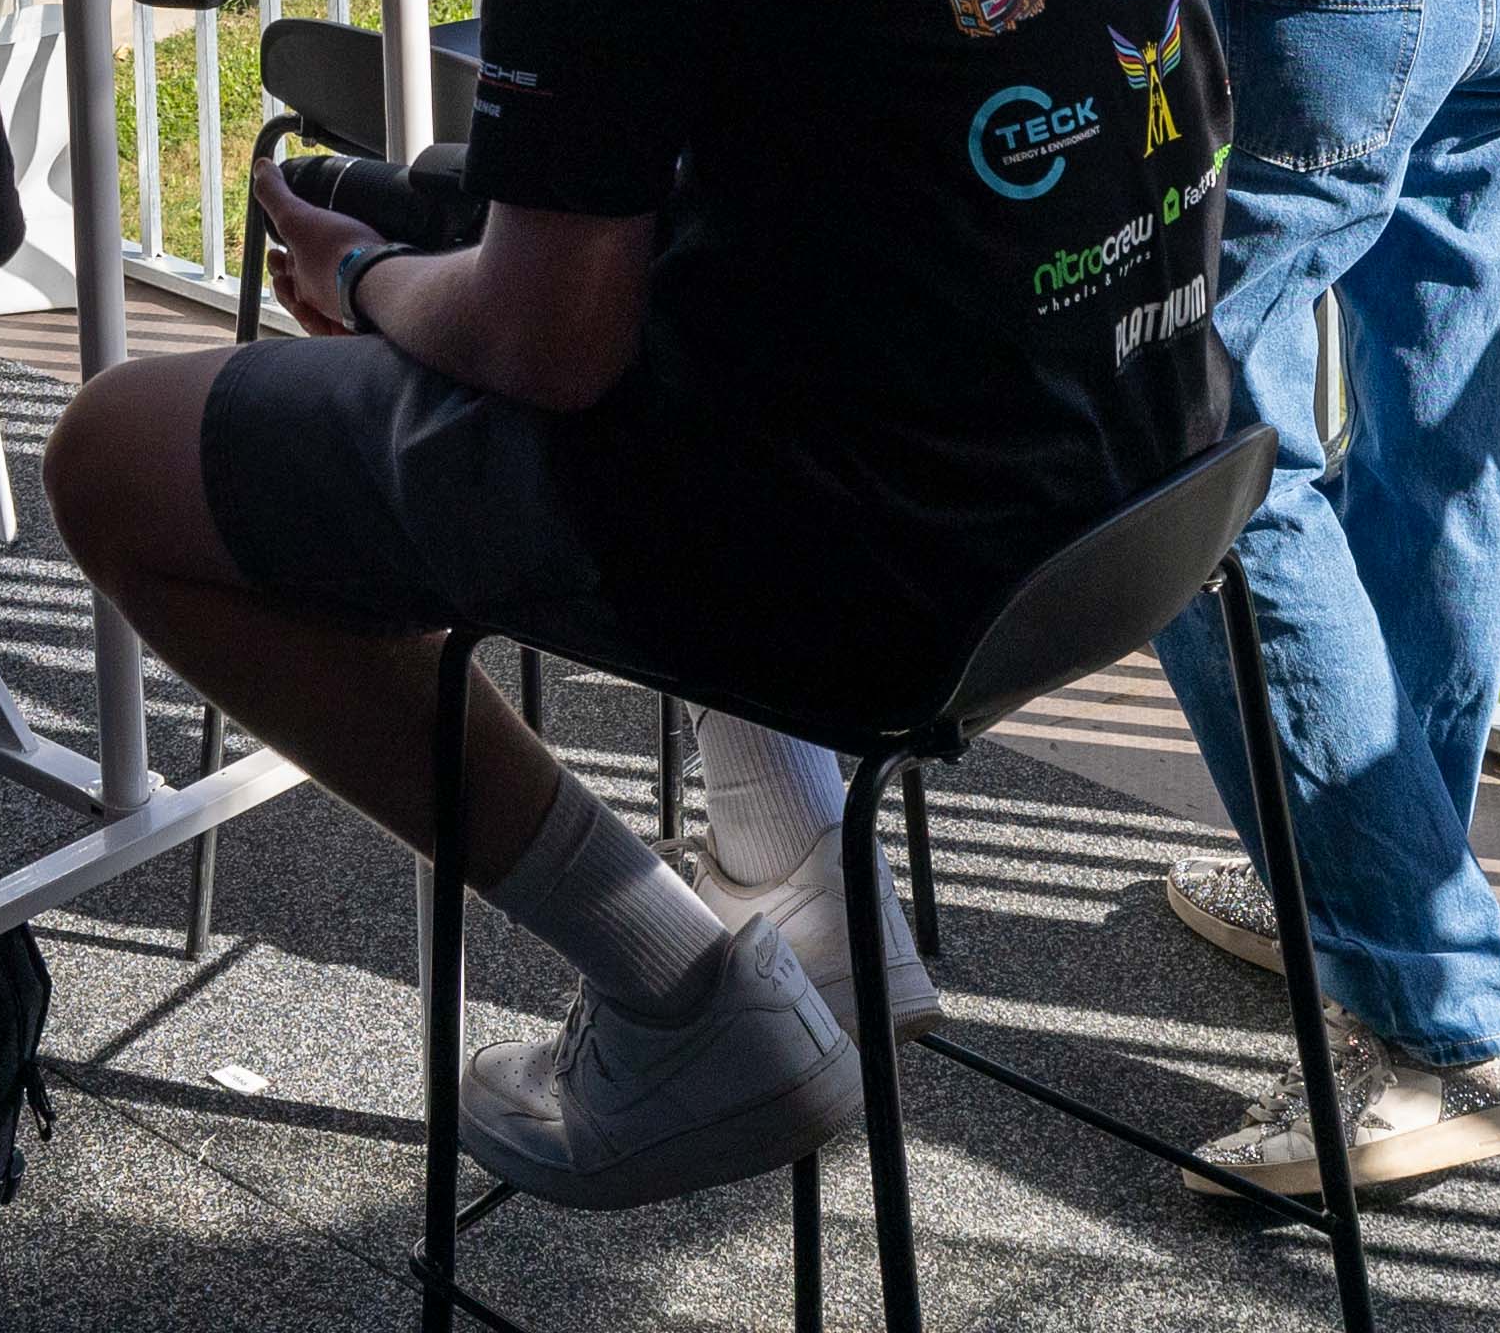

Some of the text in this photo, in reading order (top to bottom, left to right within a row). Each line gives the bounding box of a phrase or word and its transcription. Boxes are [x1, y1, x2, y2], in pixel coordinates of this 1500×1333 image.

[995, 97, 1099, 149] TECK
[1002, 125, 1101, 166] ENERGY & ENVIRONMENT
[1034, 213, 1154, 295] nitrocrew
[1038, 285, 1097, 315] wheels
[1105, 273, 1112, 286] &
